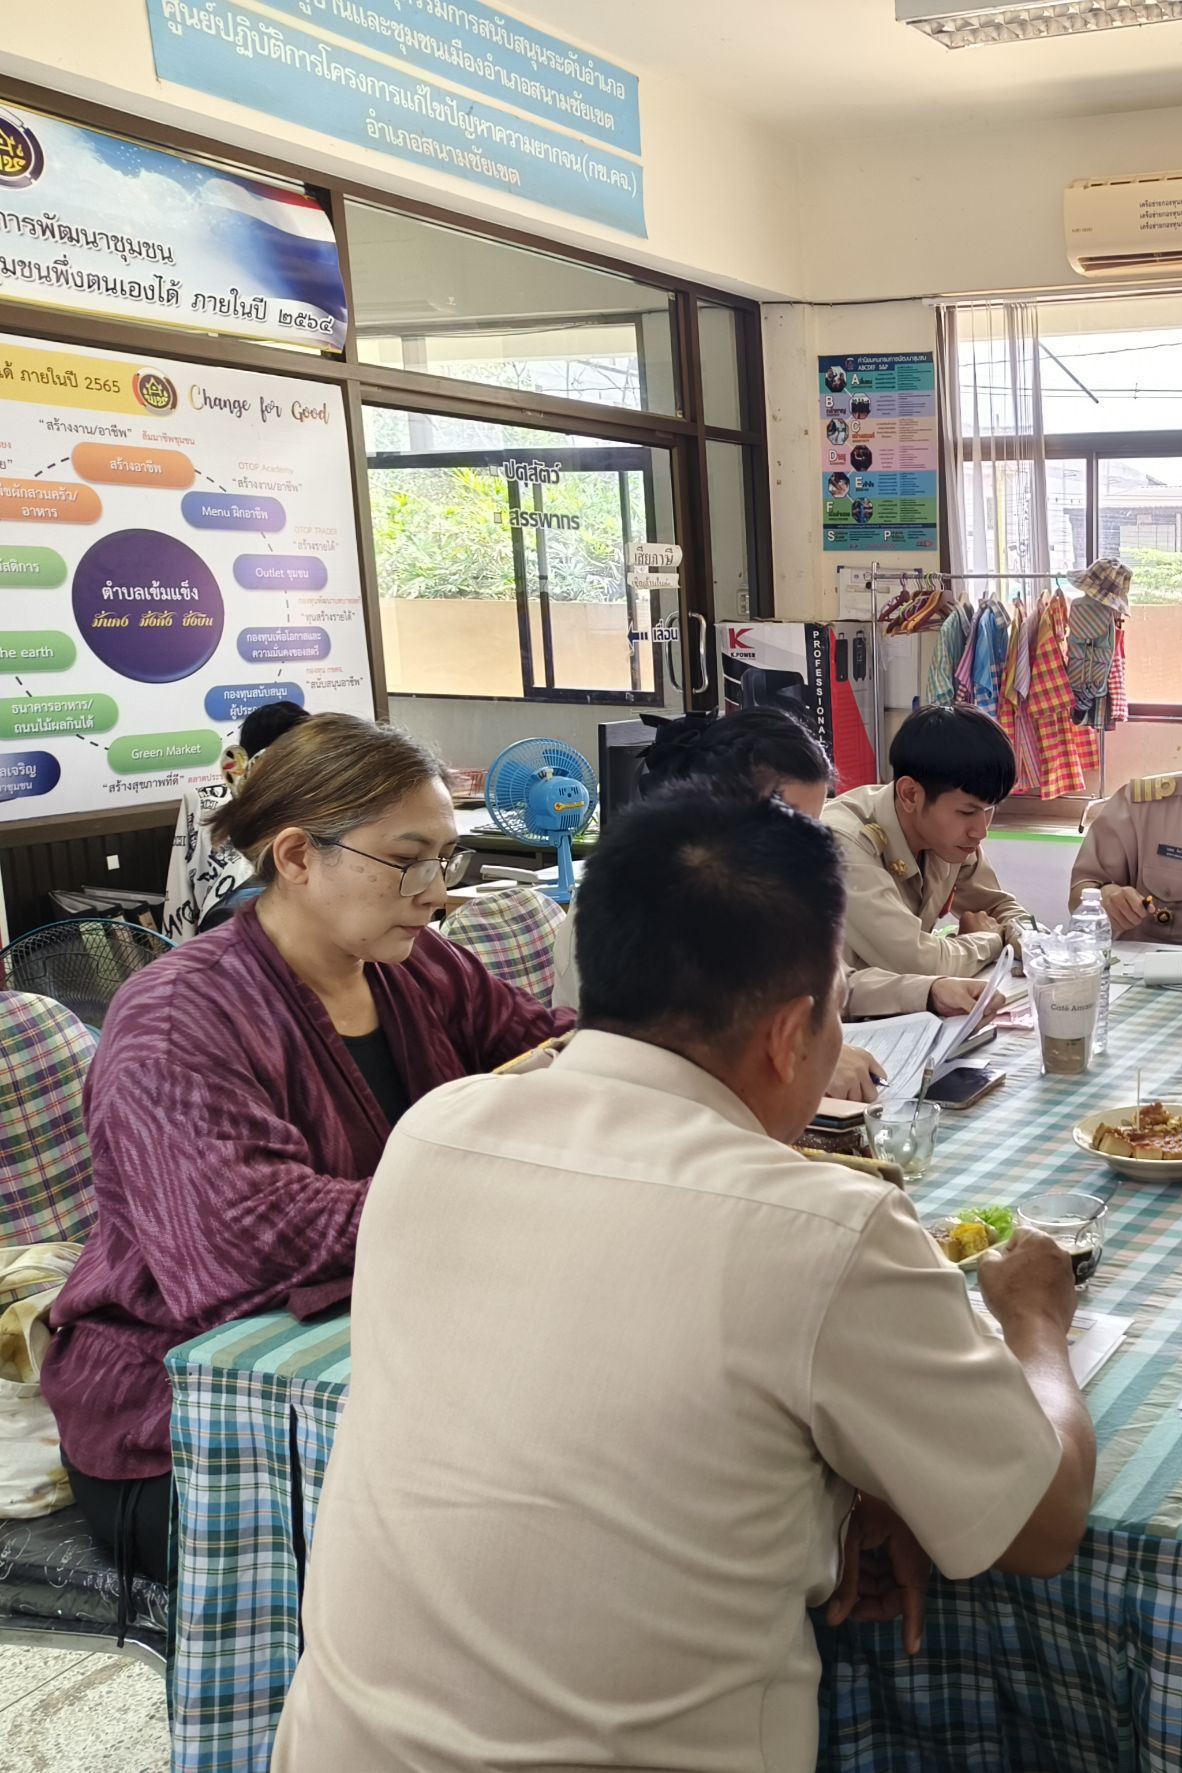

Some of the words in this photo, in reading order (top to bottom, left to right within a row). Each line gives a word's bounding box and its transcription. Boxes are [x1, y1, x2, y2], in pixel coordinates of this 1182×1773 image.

[393, 0, 625, 99] รมการสนับสนุนระดับอำเภอ
[366, 108, 521, 186] อำเภอสนามชัยเขต
[0, 254, 180, 305] มชนพึ่งตนเองได้
[191, 288, 267, 320] ภายในปี
[278, 308, 333, 332] ๒๕๖๔
[20, 367, 79, 388] ภายในปี
[84, 377, 121, 393] 2565
[189, 384, 250, 418] Change
[260, 396, 282, 422] for
[291, 400, 330, 425] Good
[109, 458, 163, 474] สร้างอาชีพ
[238, 462, 259, 471] OTOP
[503, 459, 561, 488] ปศุสัตว์
[21, 506, 58, 517] อาหาร
[202, 506, 230, 517] Menu
[231, 505, 269, 520] ฝึกอาชีพ
[509, 509, 580, 530] สรรพากร
[634, 546, 674, 566] เสียภาษี
[255, 568, 285, 578] Outlet
[286, 569, 309, 581] ชุมชน
[102, 580, 199, 600] ตำบลเข้มแข็ง
[653, 619, 678, 641] เลื่อน
[728, 627, 755, 649] K
[20, 646, 54, 658] earth
[224, 685, 288, 700] กองทุนสนับสนุน
[812, 630, 826, 744] PROFESSIONAL
[12, 698, 93, 714] ธนาคารอาหาร/
[14, 715, 94, 733] ถนนไม้ผลกินได้
[131, 748, 162, 759] Green
[166, 744, 201, 756] Market
